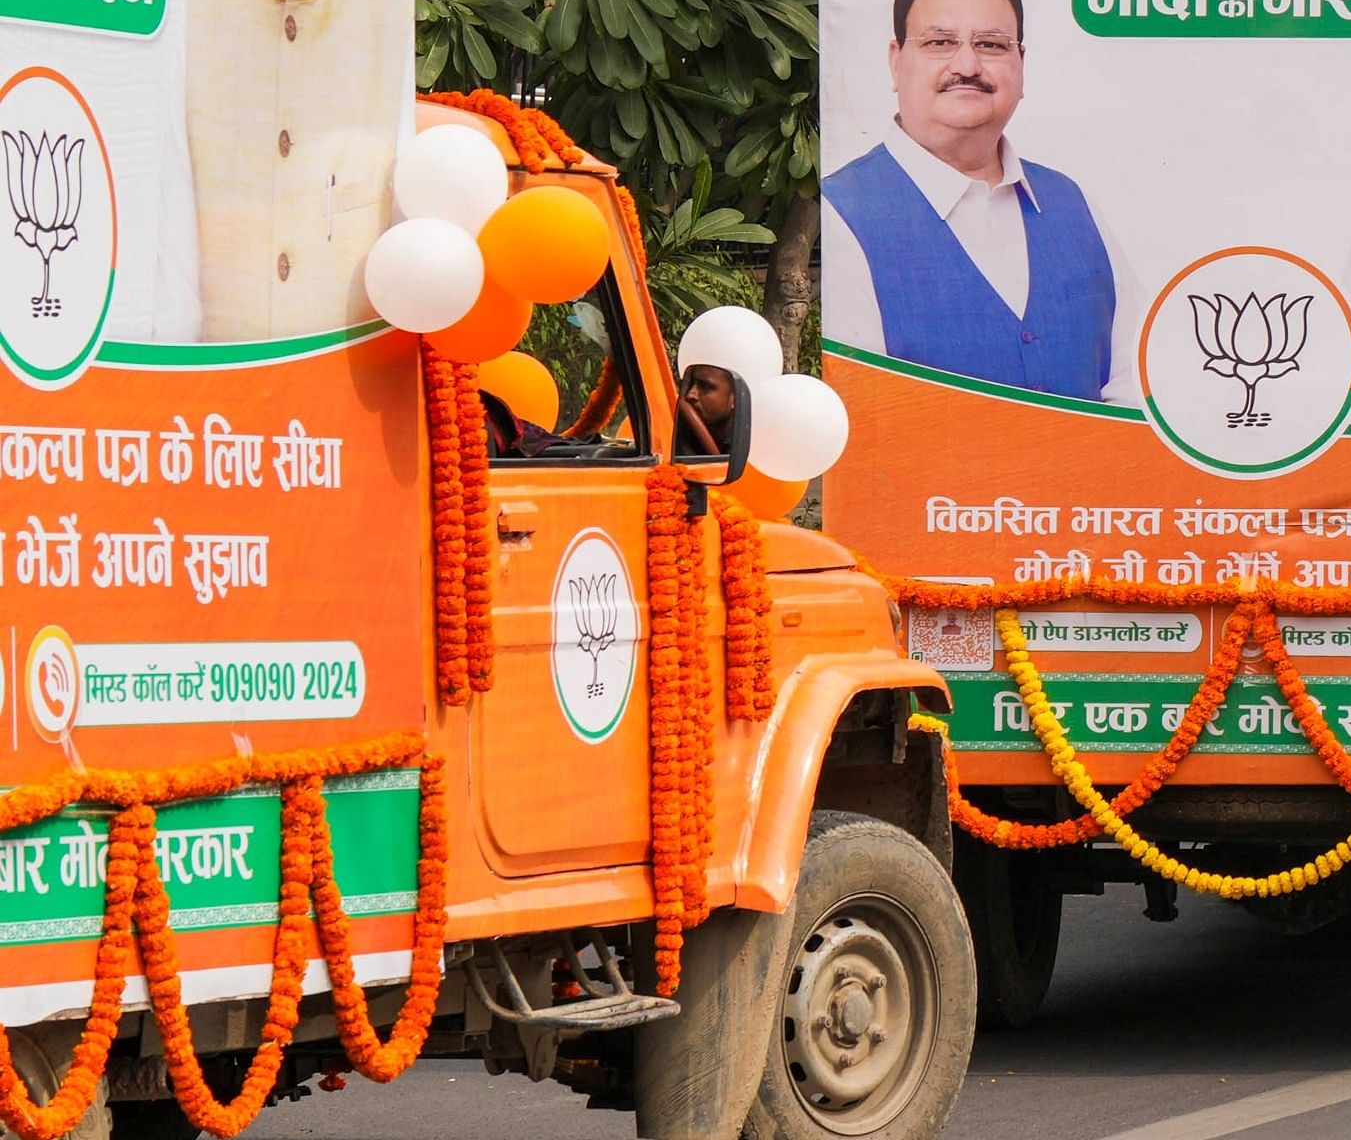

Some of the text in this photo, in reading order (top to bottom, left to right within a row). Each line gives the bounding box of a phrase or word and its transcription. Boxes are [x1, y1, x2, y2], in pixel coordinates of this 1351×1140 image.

[95, 413, 343, 489] पत्र के लिए सीधा
[926, 496, 1061, 536] विकसित
[1071, 507, 1163, 536] भारत
[1174, 498, 1288, 537] संकल्प
[16, 513, 81, 587] भेजें
[91, 518, 175, 588] अपने
[183, 535, 269, 605] सुझाव
[1158, 551, 1205, 585] को
[1042, 620, 1188, 642] ऐप डाउनलोड करें
[1282, 625, 1325, 646] मिस्ड
[85, 660, 357, 705] मिस्ड कॉल करें 909090 2024
[1084, 703, 1150, 733] एक
